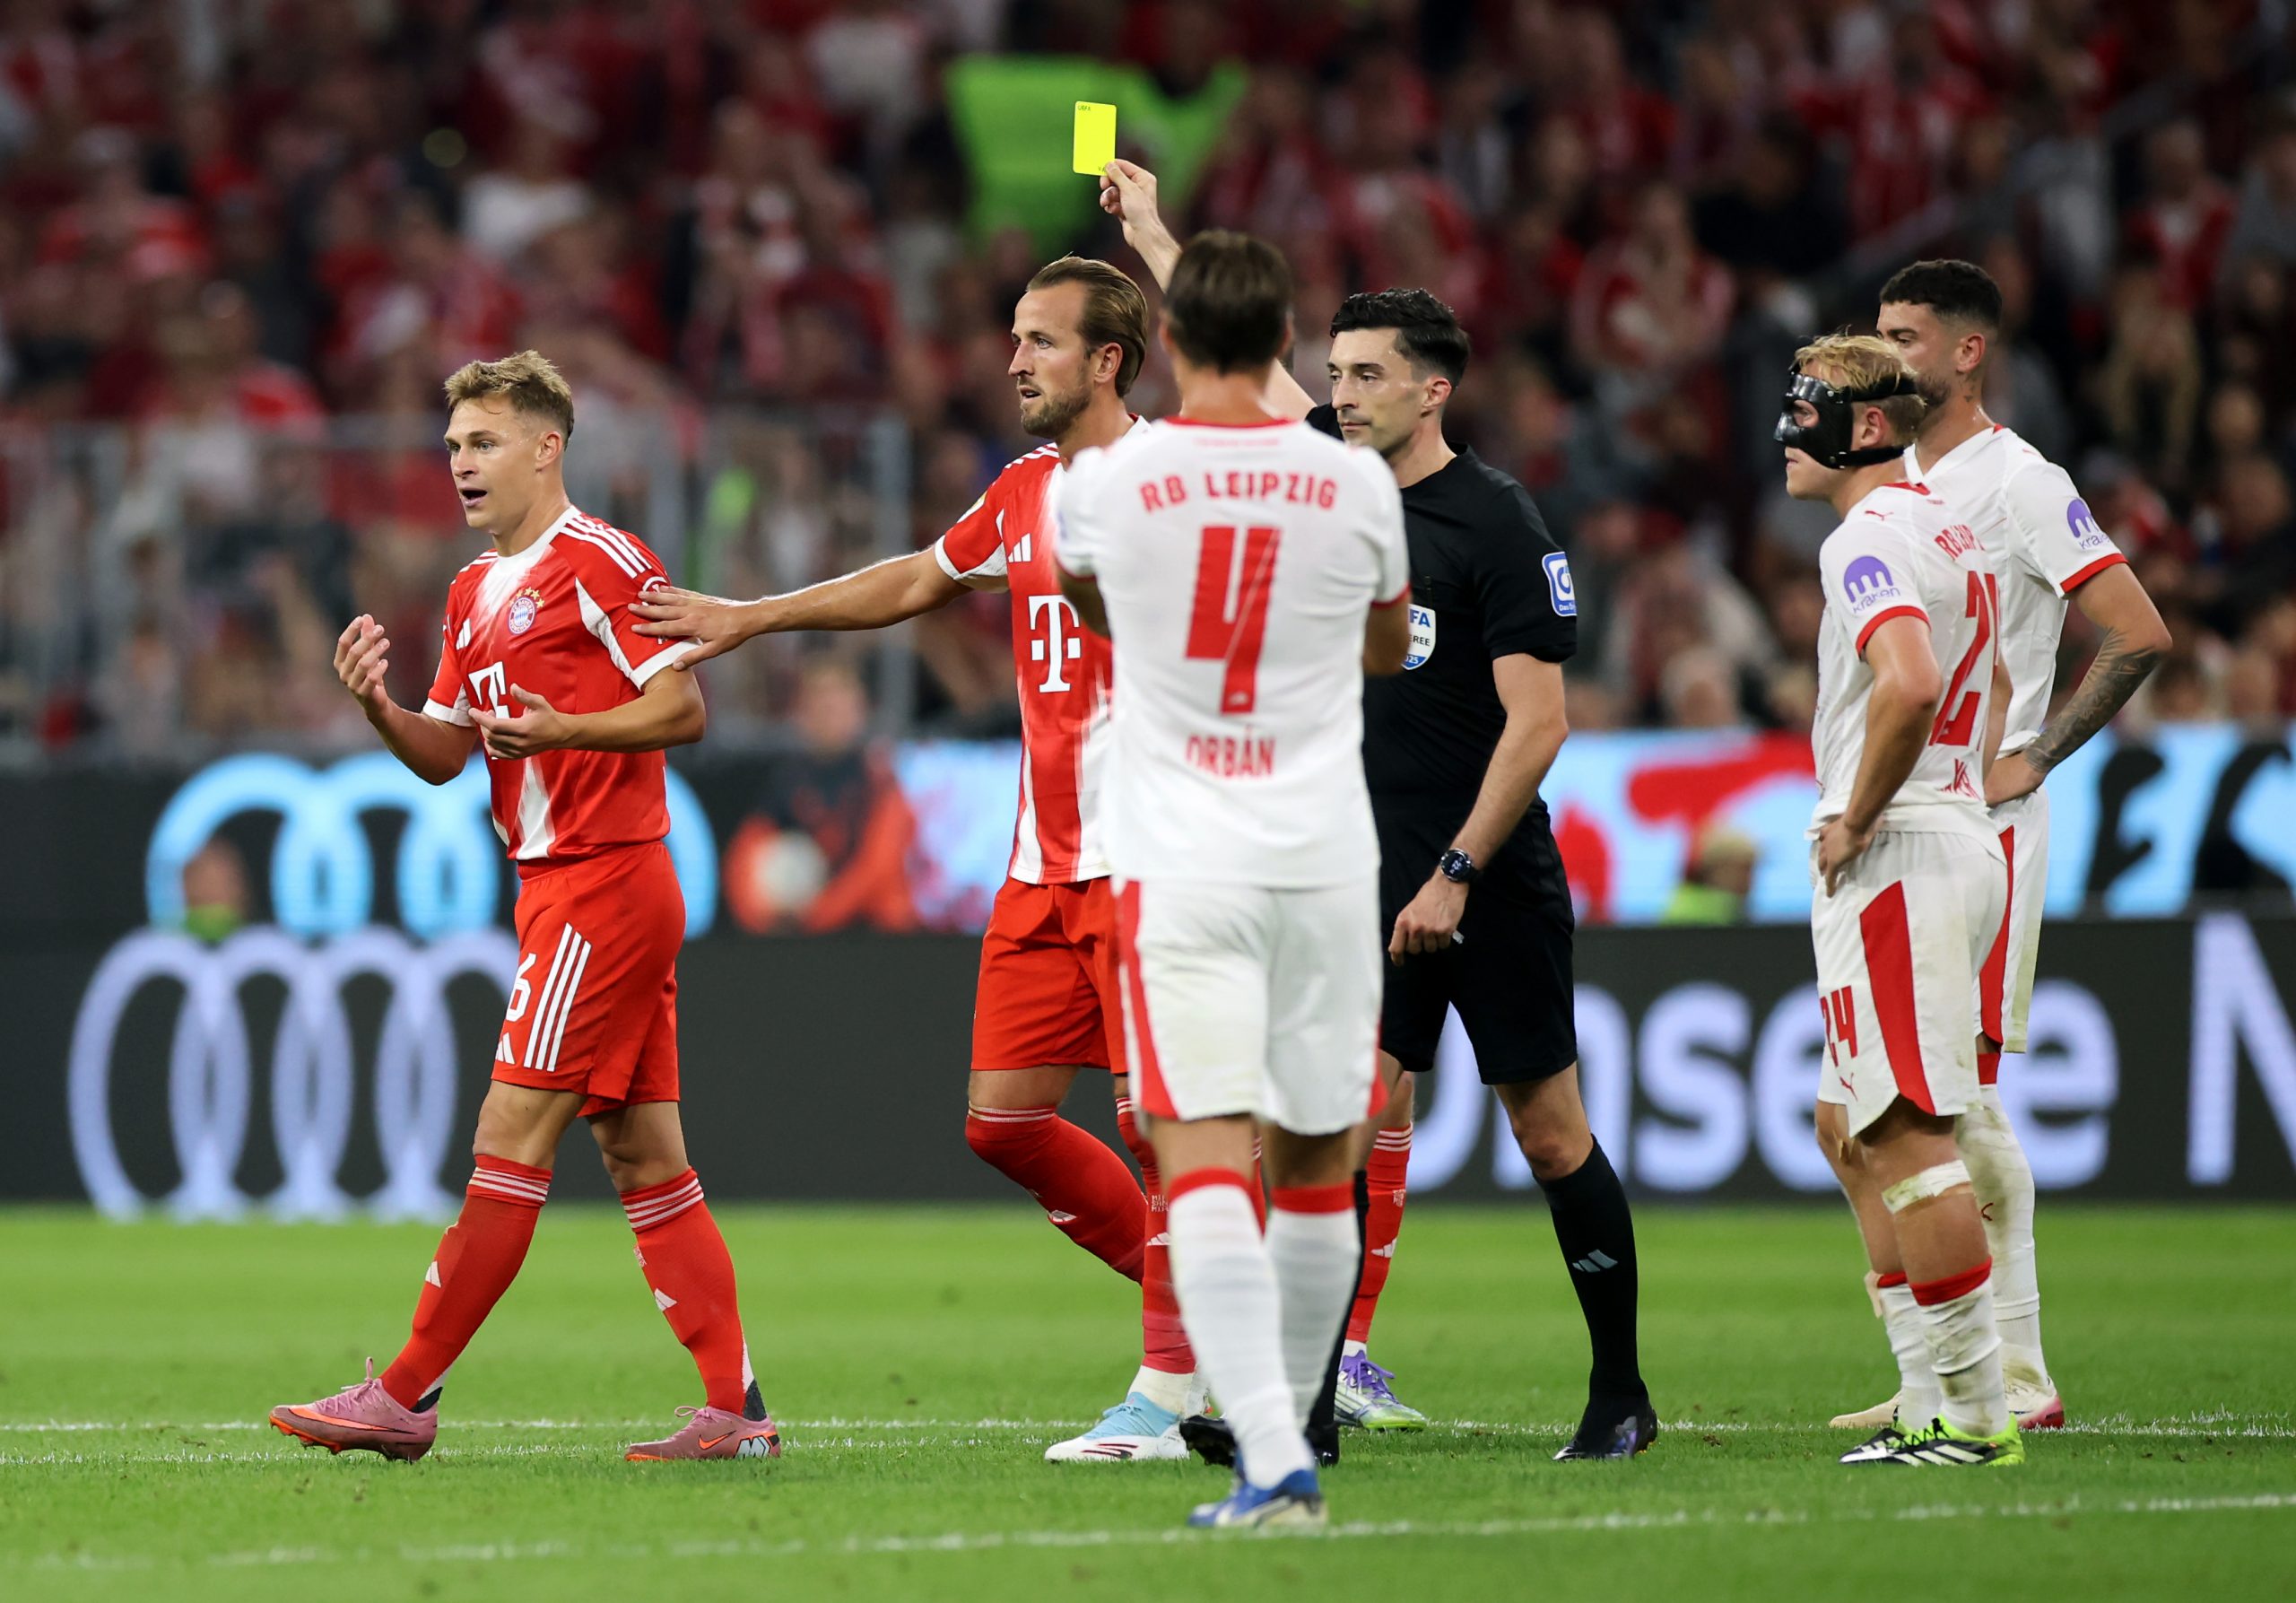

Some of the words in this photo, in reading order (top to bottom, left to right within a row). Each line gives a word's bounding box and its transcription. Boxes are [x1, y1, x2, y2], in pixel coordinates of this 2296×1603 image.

[1140, 475, 1187, 511] RB
[1205, 472, 1336, 509] LEIPZIG
[1185, 526, 1281, 714] 4
[1409, 609, 1431, 628] FA
[1853, 588, 1900, 614] kraken
[506, 953, 536, 1022] 6
[1820, 985, 1857, 1067] 24
